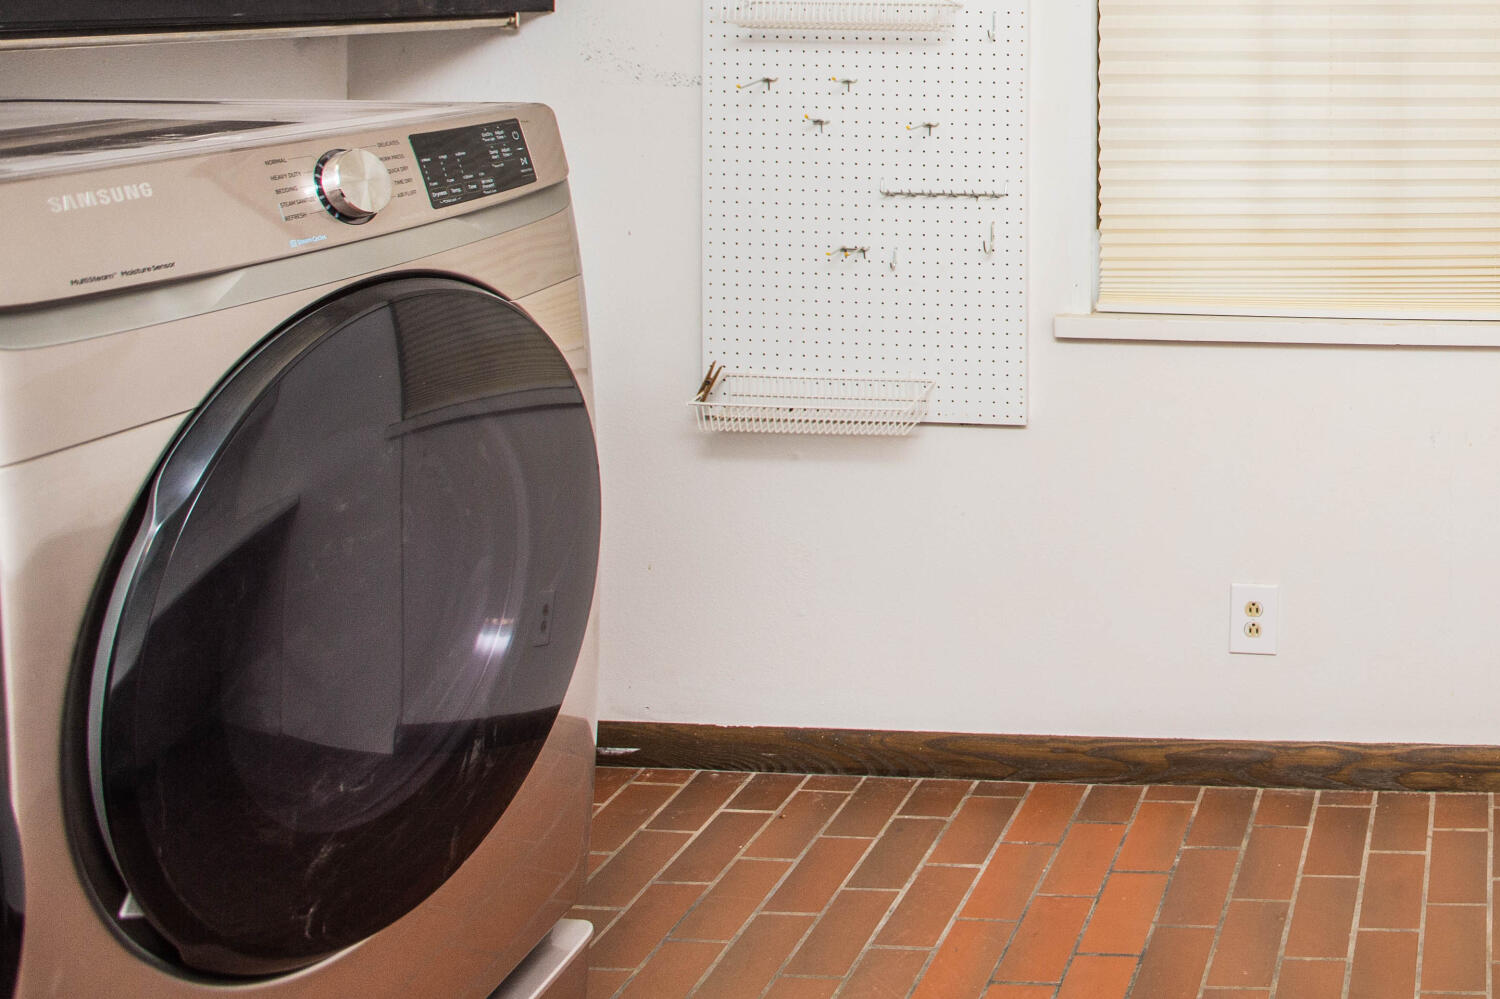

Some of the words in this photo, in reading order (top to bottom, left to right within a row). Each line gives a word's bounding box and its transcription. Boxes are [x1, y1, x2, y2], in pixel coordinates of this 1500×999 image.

[264, 158, 288, 166] NORMAL
[288, 171, 302, 179] DUTY
[47, 182, 153, 213] SAMSUNG
[120, 266, 152, 277] Moisture
[151, 261, 176, 271] Sensor
